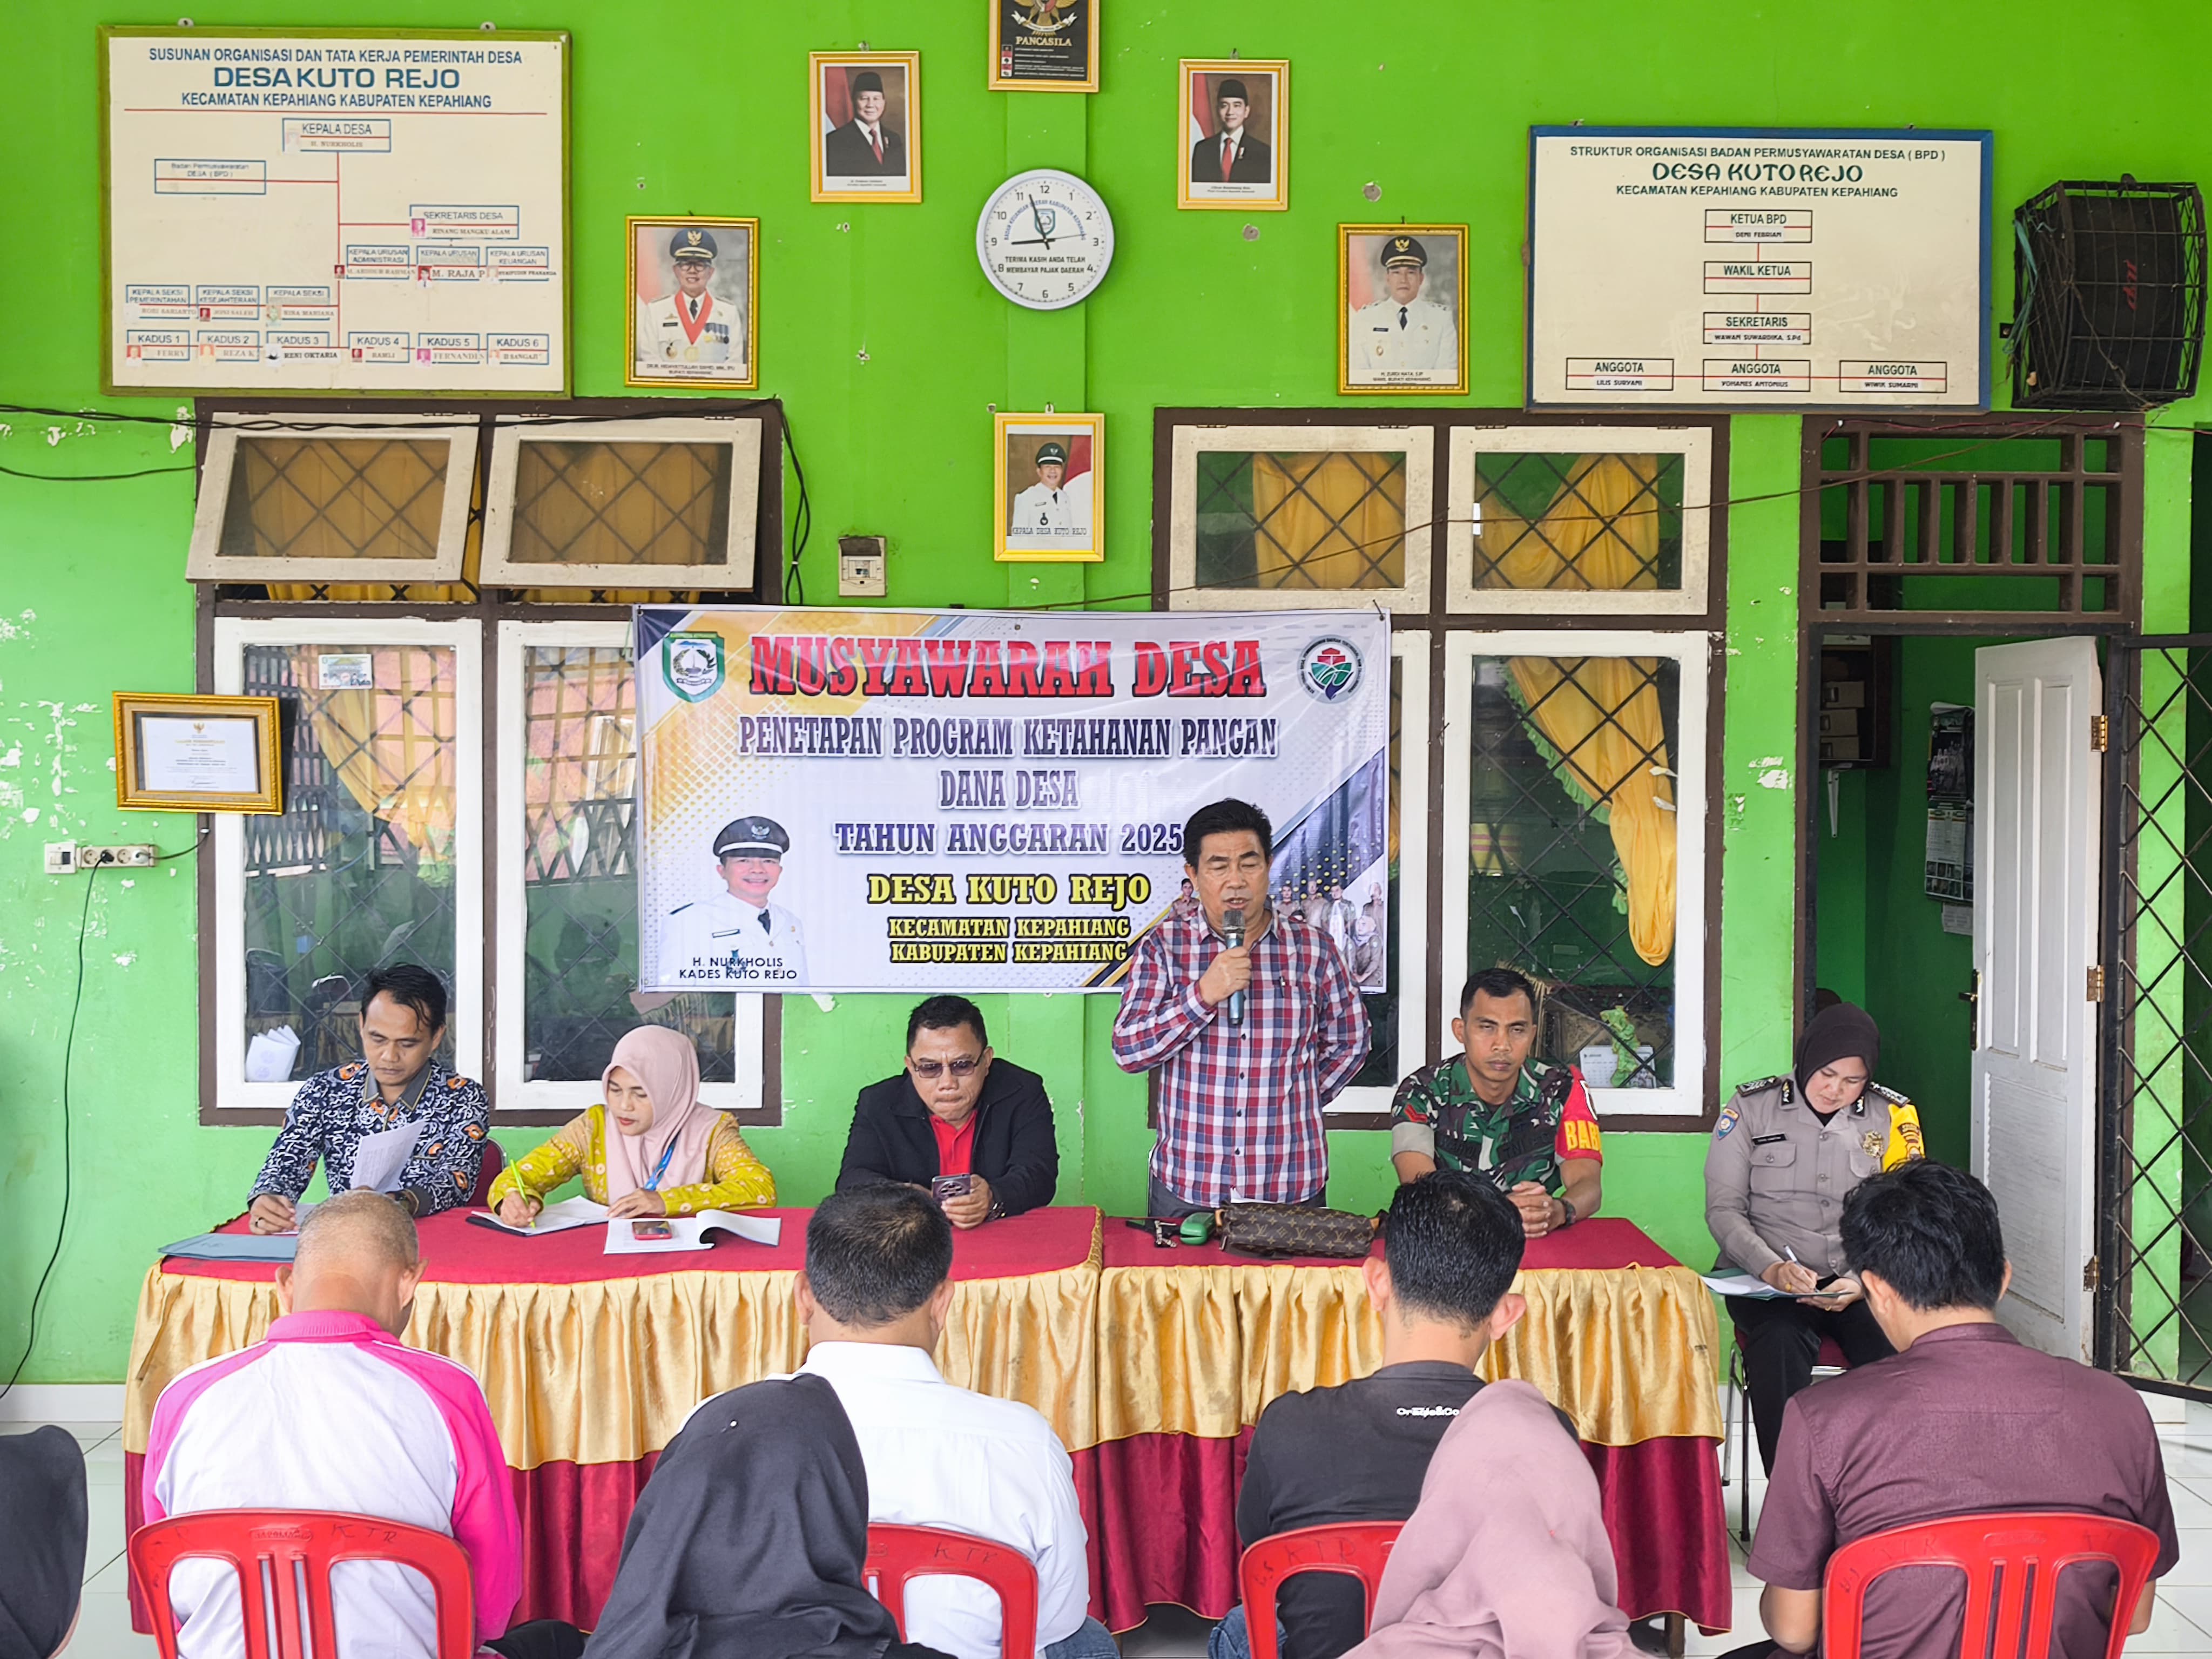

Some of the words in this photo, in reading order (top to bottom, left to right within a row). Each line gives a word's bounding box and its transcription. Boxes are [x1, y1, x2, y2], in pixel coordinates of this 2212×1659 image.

[1015, 36, 1072, 46] PANCASILA
[150, 48, 210, 60] SUSUNAN
[214, 49, 292, 61] ORGANISASI
[296, 50, 321, 61] DAN
[326, 50, 355, 62] TATA
[360, 50, 400, 62] KERJA
[404, 51, 484, 63] PEMERINTAH
[488, 51, 522, 63] DESA
[214, 68, 292, 87] DESA
[298, 68, 375, 88] KUTO
[386, 69, 460, 89] REJO
[182, 92, 259, 106] KECAMATAN
[264, 93, 336, 106] KEPAHIANG
[341, 94, 415, 107] KABUPATEN
[419, 95, 491, 107] KEPAHIANG
[302, 124, 340, 134] KEPALA
[344, 124, 372, 134] DESA
[1570, 146, 1632, 156] STRUKTUR
[1636, 146, 1707, 156] ORGANISASI
[1711, 147, 1751, 157] BADAN
[1755, 148, 1871, 159] PERMUSYAWARATAN
[1874, 150, 1905, 159] DESA
[1653, 162, 1721, 180] DESA
[1728, 164, 1795, 181] KUTO
[1800, 164, 1863, 182] REJO
[1017, 192, 1023, 200] 11
[1070, 192, 1073, 200] 1
[1616, 185, 1687, 195] KECAMATAN
[1691, 186, 1756, 195] KEPAHIANG
[1761, 187, 1828, 196] KABUPATEN
[1832, 187, 1898, 197] KEPAHIANG
[997, 212, 1007, 220] 10
[1086, 212, 1092, 220] 2
[1730, 214, 1764, 224] KETUA
[1766, 214, 1786, 224] BPD
[991, 238, 997, 246] 9
[1724, 265, 1755, 275] WAKIL
[1758, 265, 1791, 275] KETUA
[1068, 283, 1074, 291] 5
[1726, 317, 1788, 327] SEKRETARIS
[138, 335, 172, 343] KADUS
[176, 335, 180, 343] 1
[207, 335, 241, 343] KADUS
[243, 335, 249, 343] 2
[276, 336, 311, 345] KADUS
[313, 336, 319, 345] 3
[357, 337, 391, 346] KADUS
[393, 338, 399, 346] 4
[427, 338, 462, 346] KADUS
[464, 338, 470, 346] 5
[496, 339, 530, 347] KADUS
[1595, 362, 1644, 372] ANGGOTA
[1731, 363, 1781, 374] ANGGOTA
[1868, 365, 1917, 375] ANGGOTA
[750, 635, 1114, 697] MUSYAWARAH
[1132, 639, 1267, 697] DESA
[739, 716, 883, 755] PENETAPAN
[893, 718, 1013, 755] PROGRAM
[1023, 718, 1171, 756] KETAHANAN
[1181, 718, 1277, 756] PANGAN
[940, 770, 1006, 807] DANA
[1016, 770, 1077, 807] DESA
[834, 823, 935, 852] TAHUN
[947, 823, 1108, 852] ANGGARAN
[1121, 824, 1182, 852] 2025
[867, 874, 956, 904] DESA
[967, 874, 1056, 904] KUTO
[1069, 874, 1151, 911] REJO
[887, 917, 1009, 938] KECAMATAN
[1015, 917, 1130, 938] KEPAHIANG
[890, 941, 1007, 963] KABUPATEN
[1013, 941, 1128, 963] KEPAHIANG
[693, 958, 704, 967] H.
[710, 958, 783, 967] NURKHOLIS
[679, 969, 720, 979] KADES
[726, 969, 759, 979] KUTO
[765, 970, 797, 979] REJO
